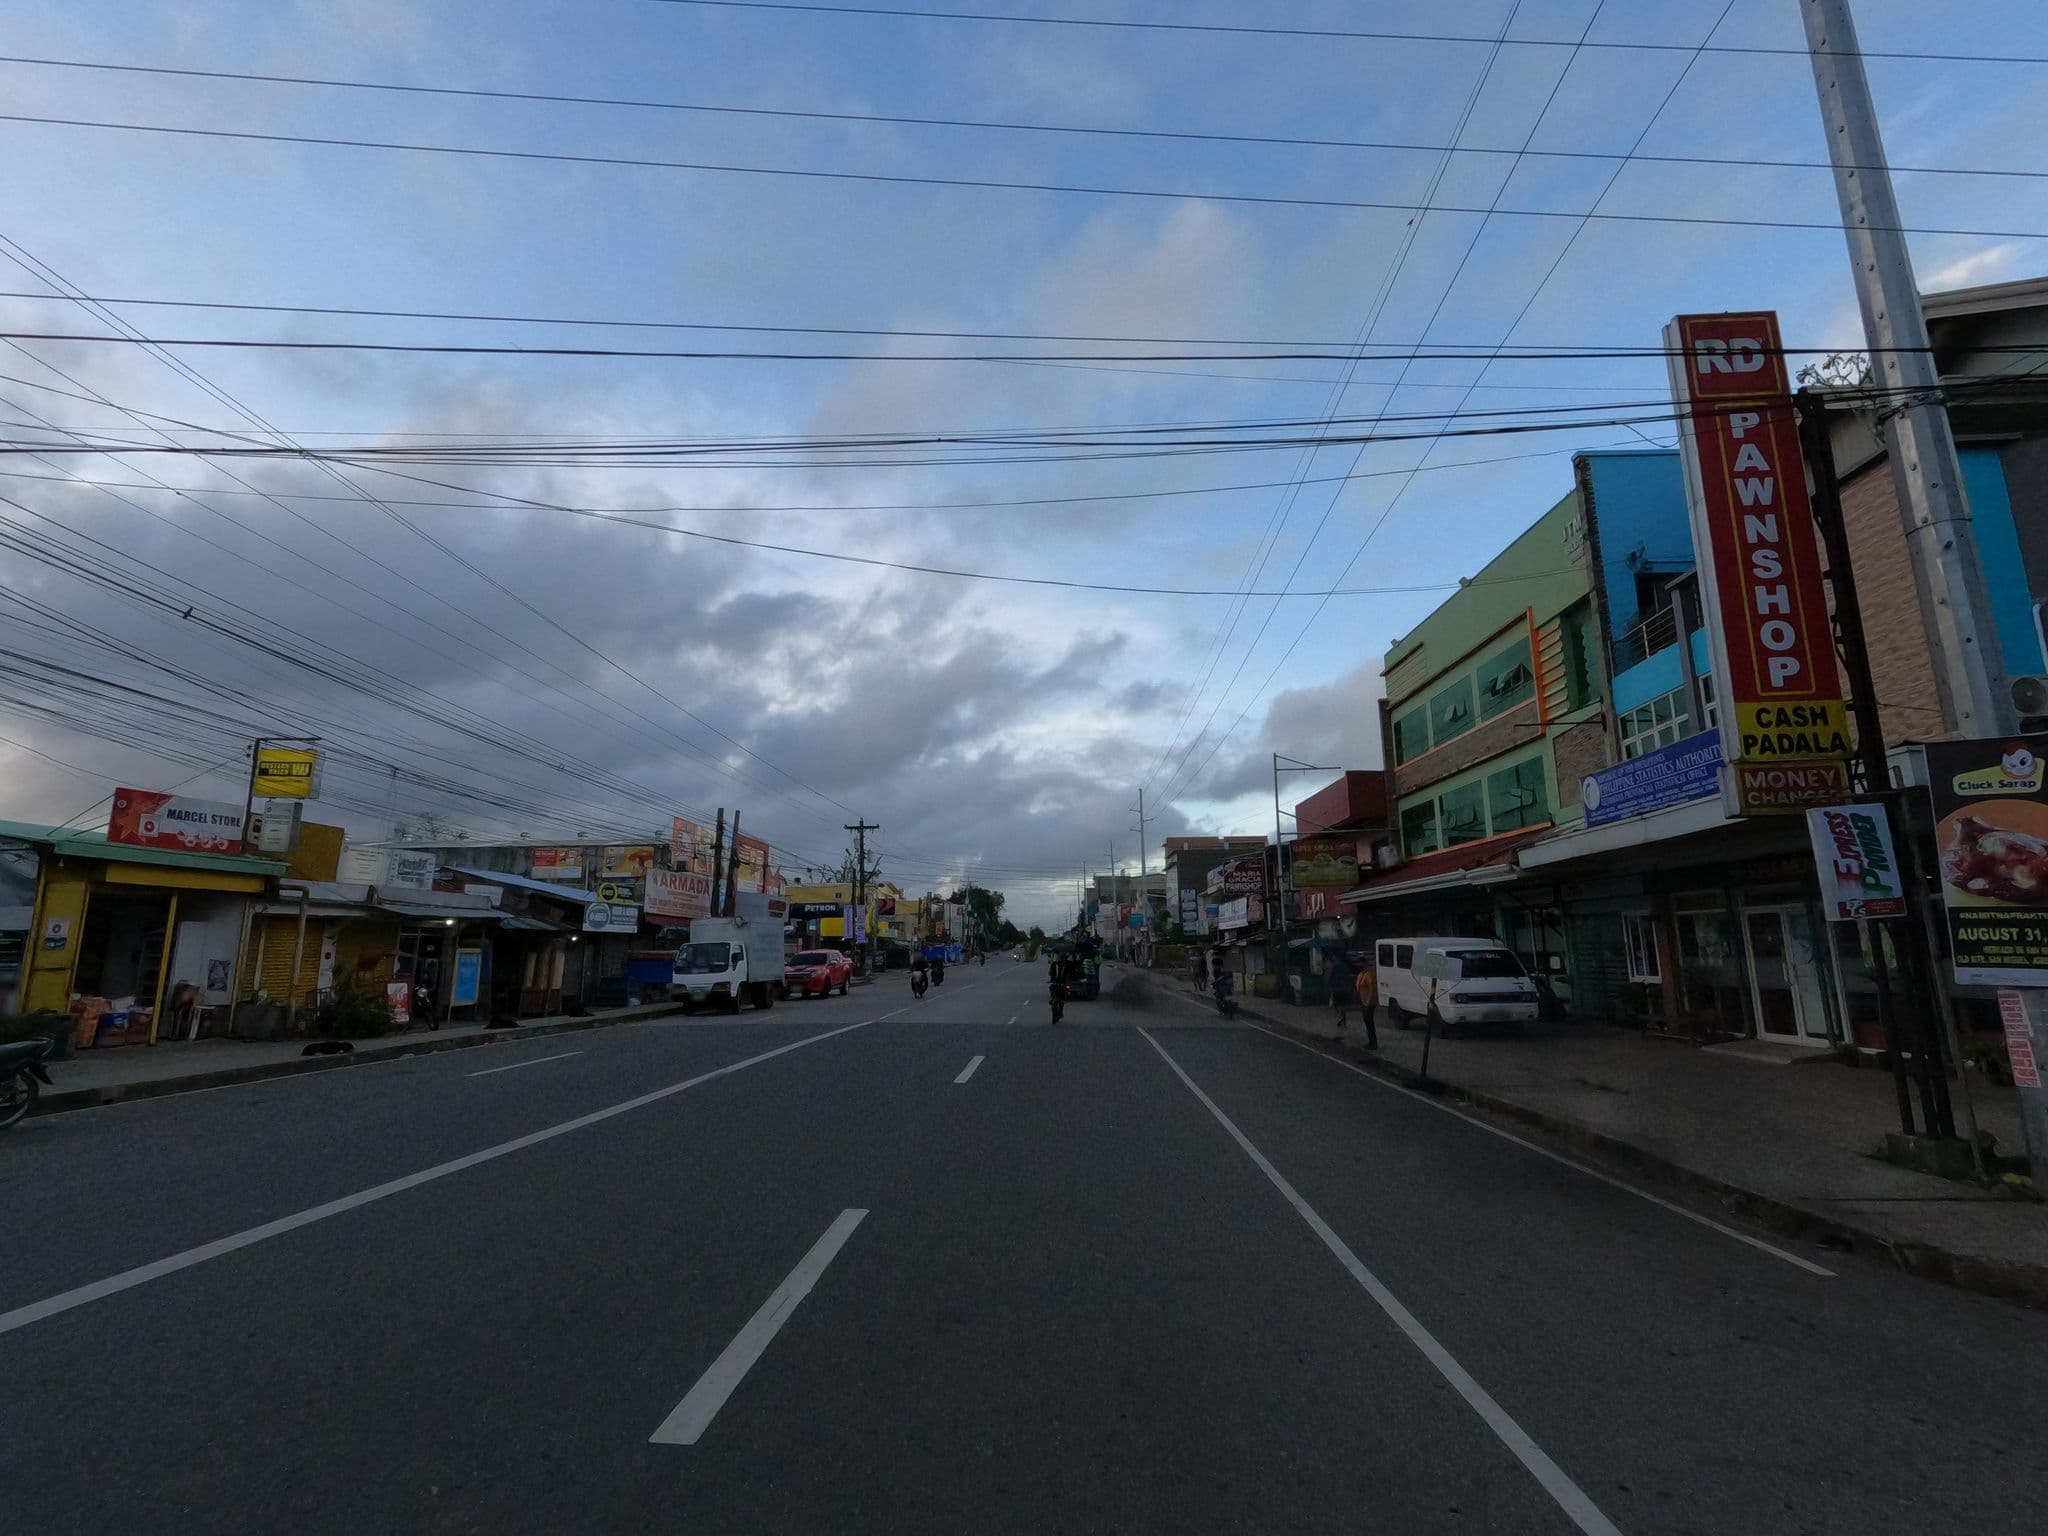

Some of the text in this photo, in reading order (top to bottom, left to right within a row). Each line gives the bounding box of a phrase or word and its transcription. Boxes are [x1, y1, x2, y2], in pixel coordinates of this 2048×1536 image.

[1695, 337, 1765, 374] RD
[1728, 412, 1800, 688] PAWNSHOP
[1755, 705, 1829, 728] CASH
[1743, 732, 1847, 755] PADALA
[1600, 776, 1634, 796] PHILIPPINE
[1634, 760, 1673, 784] STATISTICS
[1675, 744, 1723, 770] AUTHORITY
[1743, 769, 1836, 789] MONEY
[1958, 779, 2036, 790] Cluck Sarap
[166, 808, 241, 828] MARCEL STORE
[660, 872, 710, 896] ARMADA
[1232, 870, 1262, 878] MARIA
[804, 904, 837, 913] PETRON
[1957, 927, 2048, 944] AUGUST 31,
